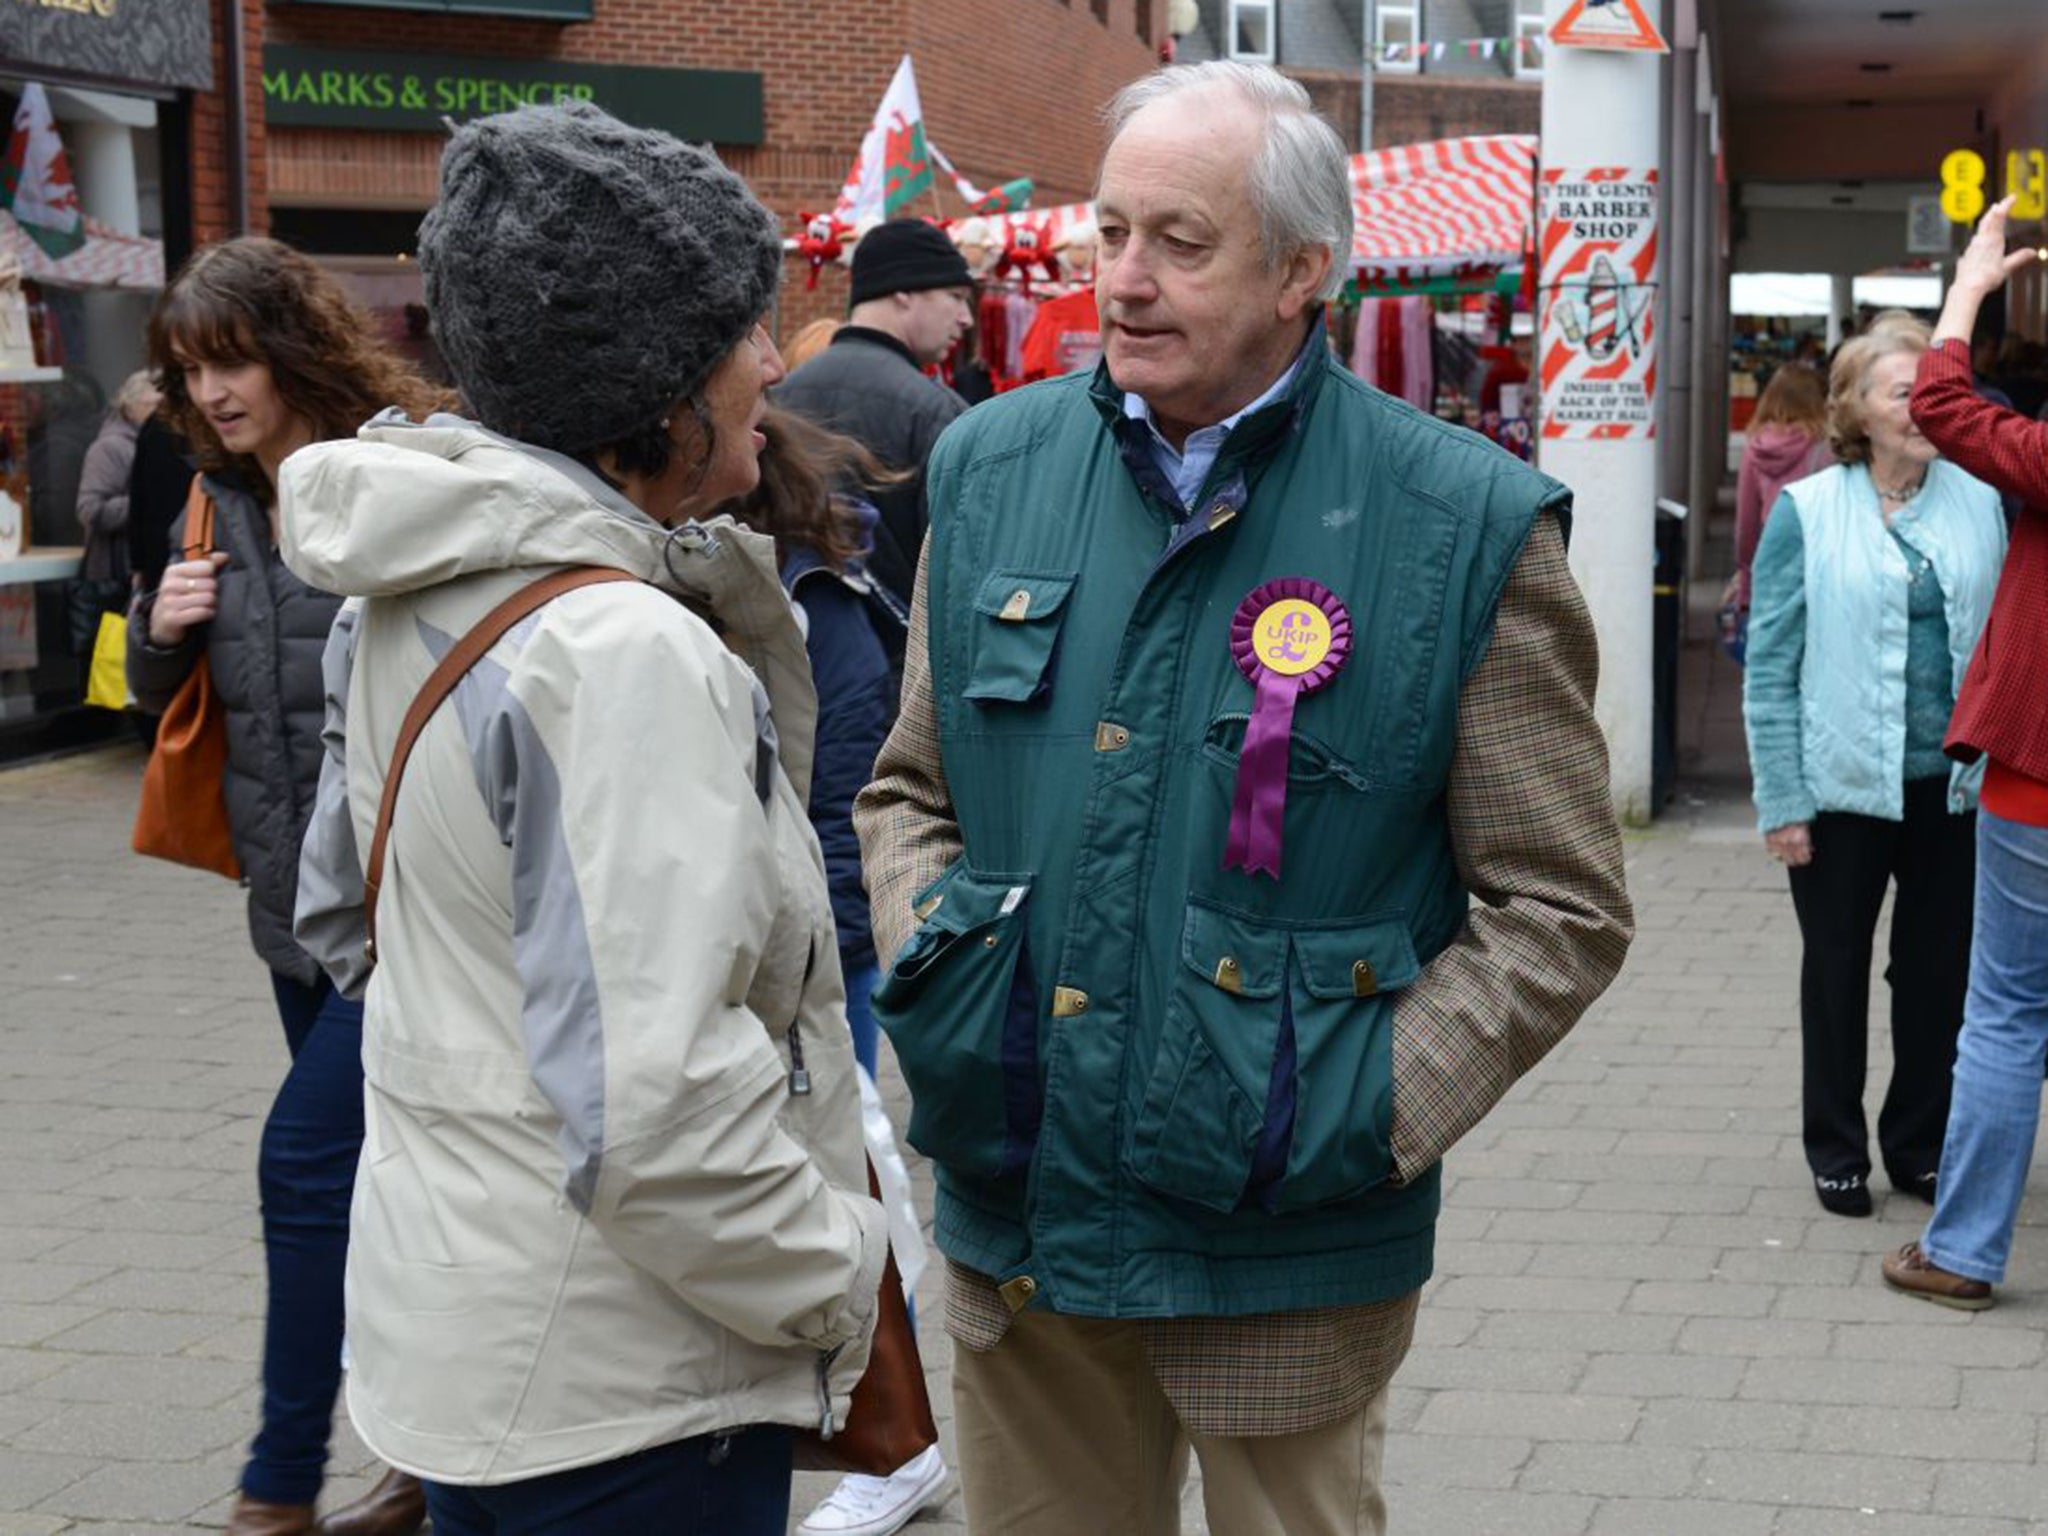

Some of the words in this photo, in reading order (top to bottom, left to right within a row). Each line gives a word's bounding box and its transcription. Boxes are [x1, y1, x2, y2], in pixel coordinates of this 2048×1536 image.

[263, 71, 394, 108] MARKS
[401, 76, 426, 109] &
[1557, 184, 1591, 197] THE
[1558, 202, 1650, 218] BARBER
[1574, 222, 1638, 238] SHOP
[1559, 397, 1594, 407] BACK
[1600, 397, 1618, 407] OF
[1556, 411, 1613, 420] MARKET
[1618, 411, 1648, 421] HALL
[1267, 625, 1319, 645] UKIP
